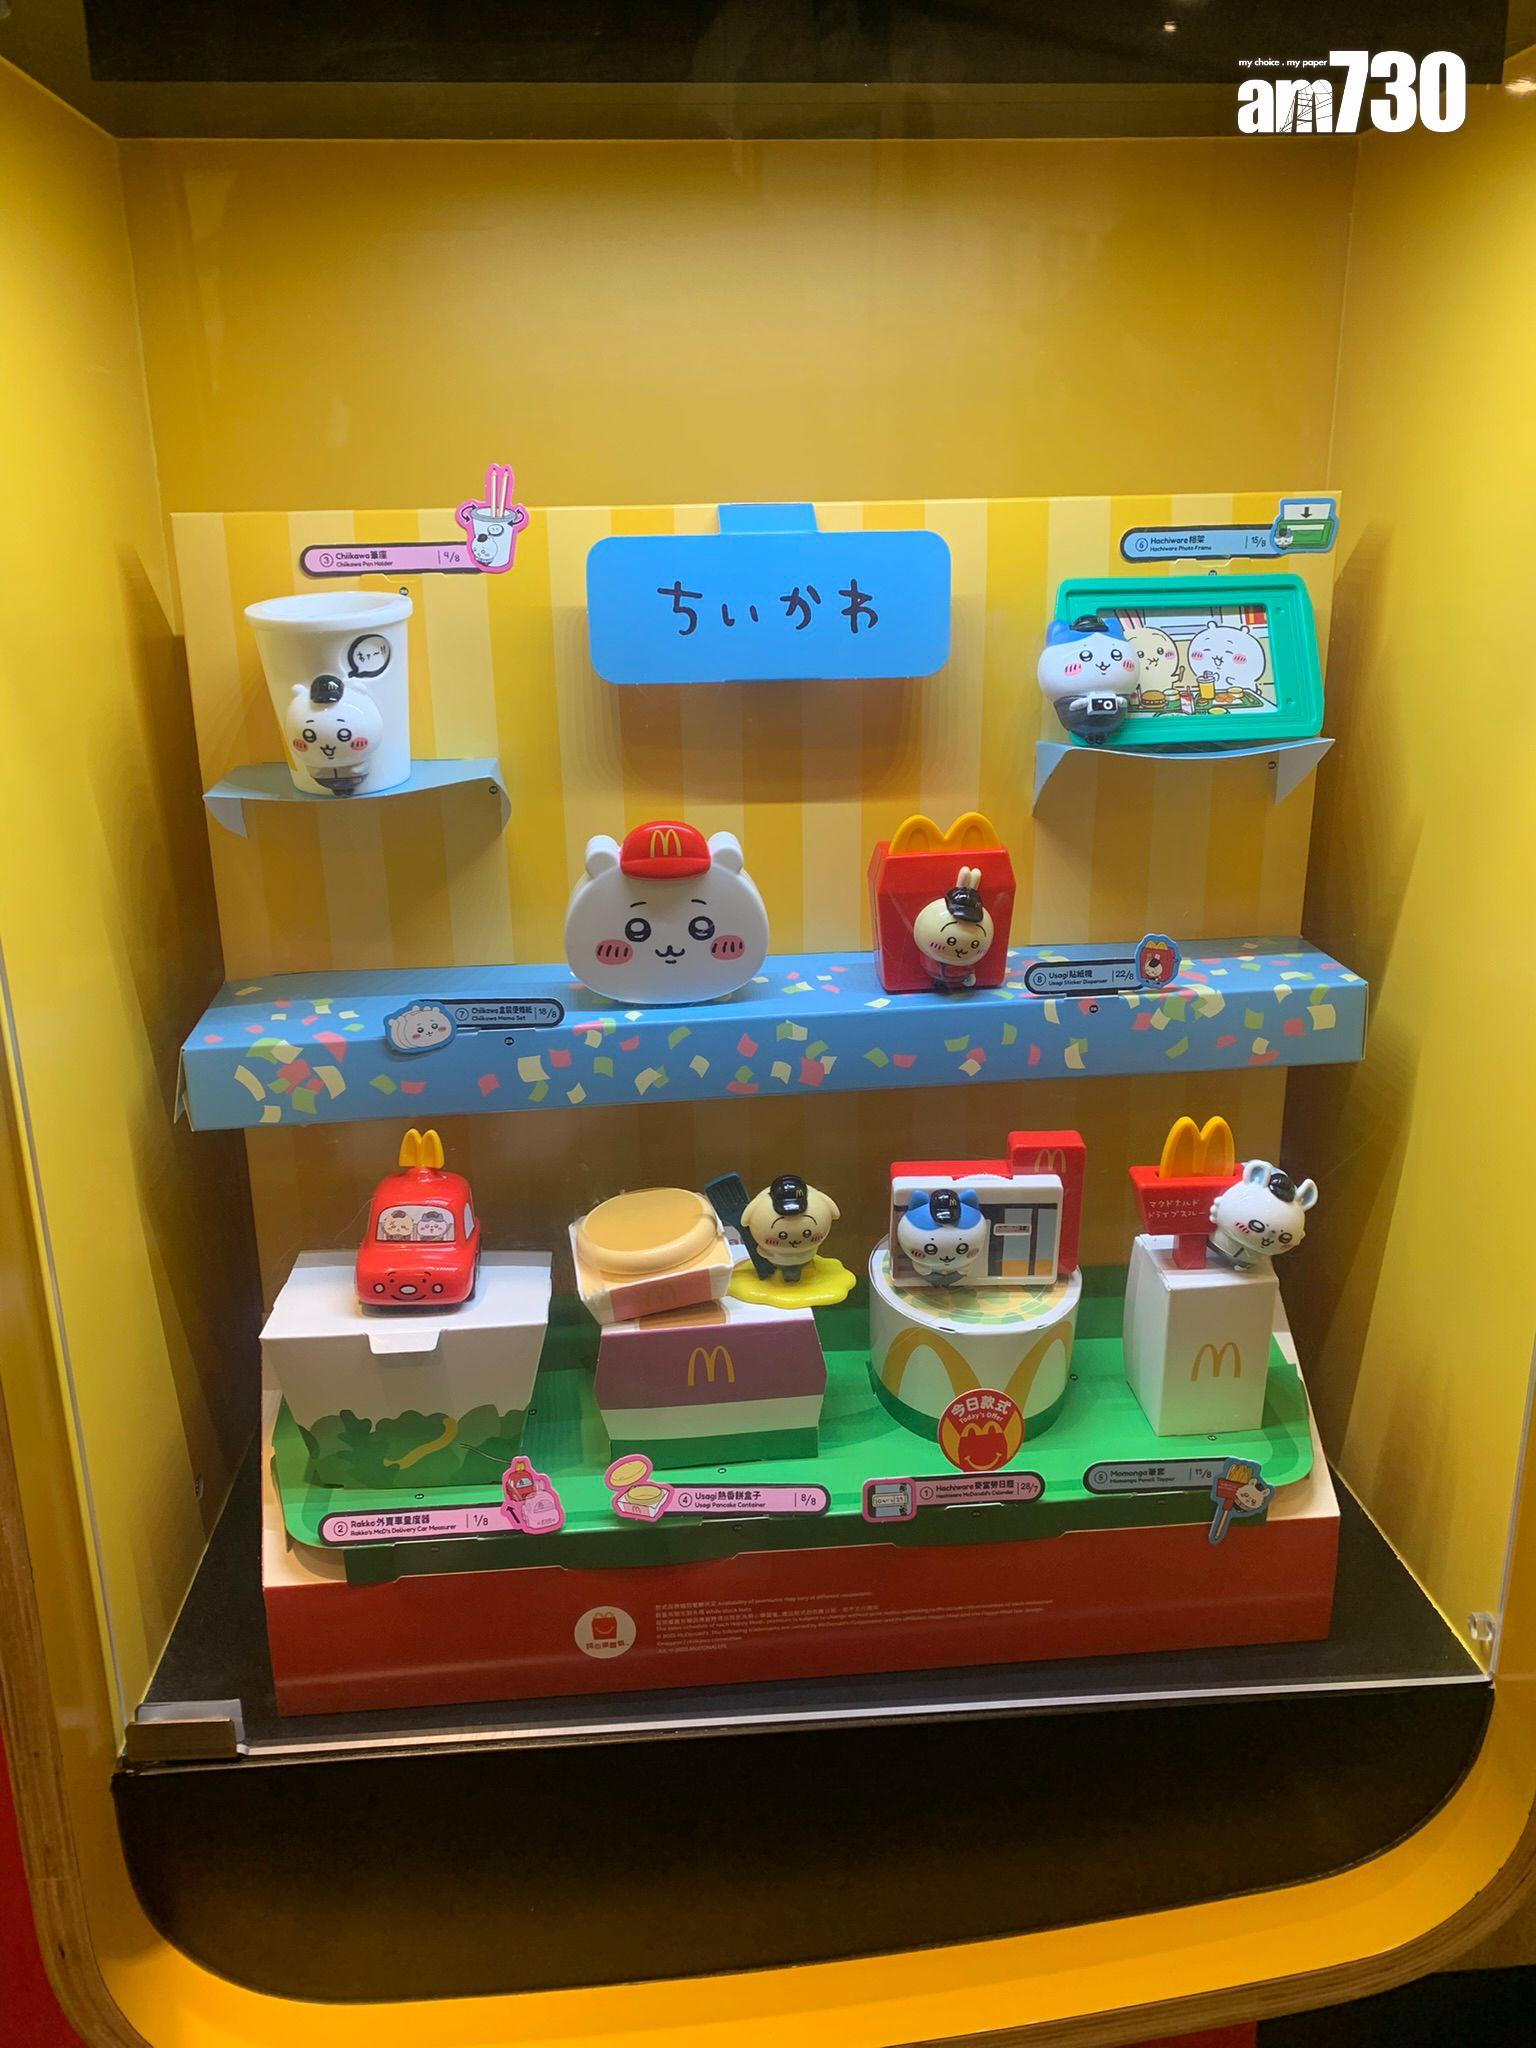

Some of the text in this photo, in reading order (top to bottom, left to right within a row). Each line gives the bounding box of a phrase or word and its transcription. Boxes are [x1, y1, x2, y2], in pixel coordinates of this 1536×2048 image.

[1251, 536, 1266, 548] 15/8
[336, 552, 370, 560] Chiikawa
[657, 578, 878, 636] ちいかわ
[1048, 972, 1069, 980] Usagi
[1116, 970, 1134, 980] 22/8
[538, 1008, 557, 1018] 18/8
[1149, 1200, 1200, 1208] マクドナルド
[1148, 1210, 1206, 1218] ドライブスルー
[952, 1395, 1012, 1418] 今日款式
[960, 1412, 1004, 1424] Today's Offer
[1020, 1482, 1038, 1493] 28/7
[695, 1492, 717, 1501] Usagi
[800, 1494, 817, 1506] 8/8
[350, 1520, 376, 1528] Rakko
[473, 1514, 489, 1527] 1/8
[392, 1526, 416, 1534] Delivery
